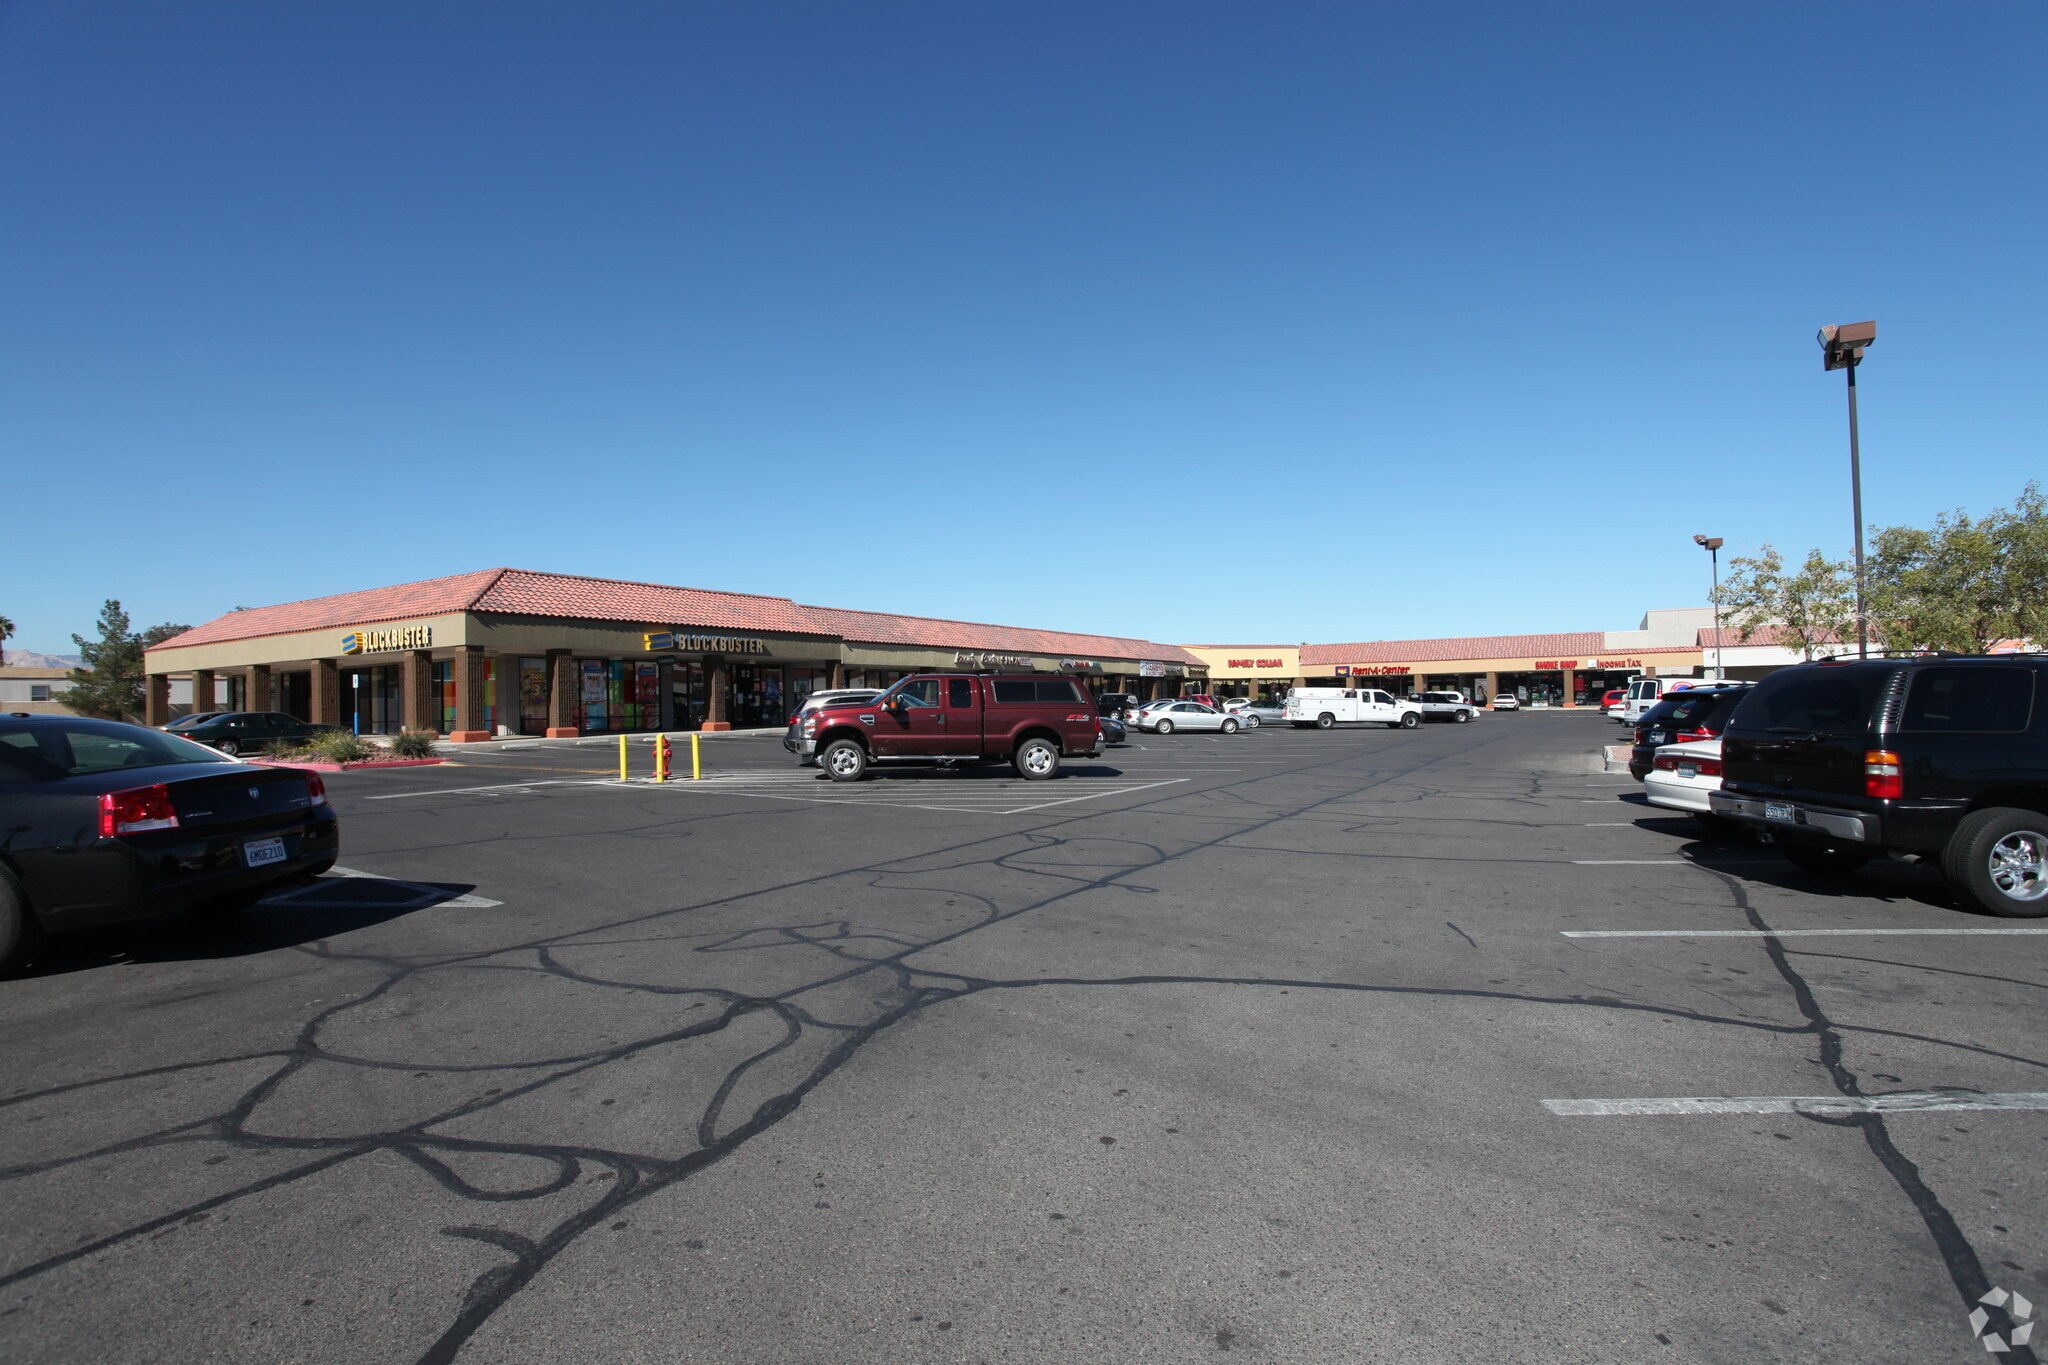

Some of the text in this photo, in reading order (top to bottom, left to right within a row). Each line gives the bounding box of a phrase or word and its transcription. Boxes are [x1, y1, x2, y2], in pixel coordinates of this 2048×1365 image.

[362, 625, 430, 650] BLOCKBUSTER
[676, 633, 763, 653] BLOCKBUSTER
[1228, 659, 1254, 668] FAMILY
[1535, 660, 1577, 670] SMOKE SHOP
[741, 669, 750, 678] E2
